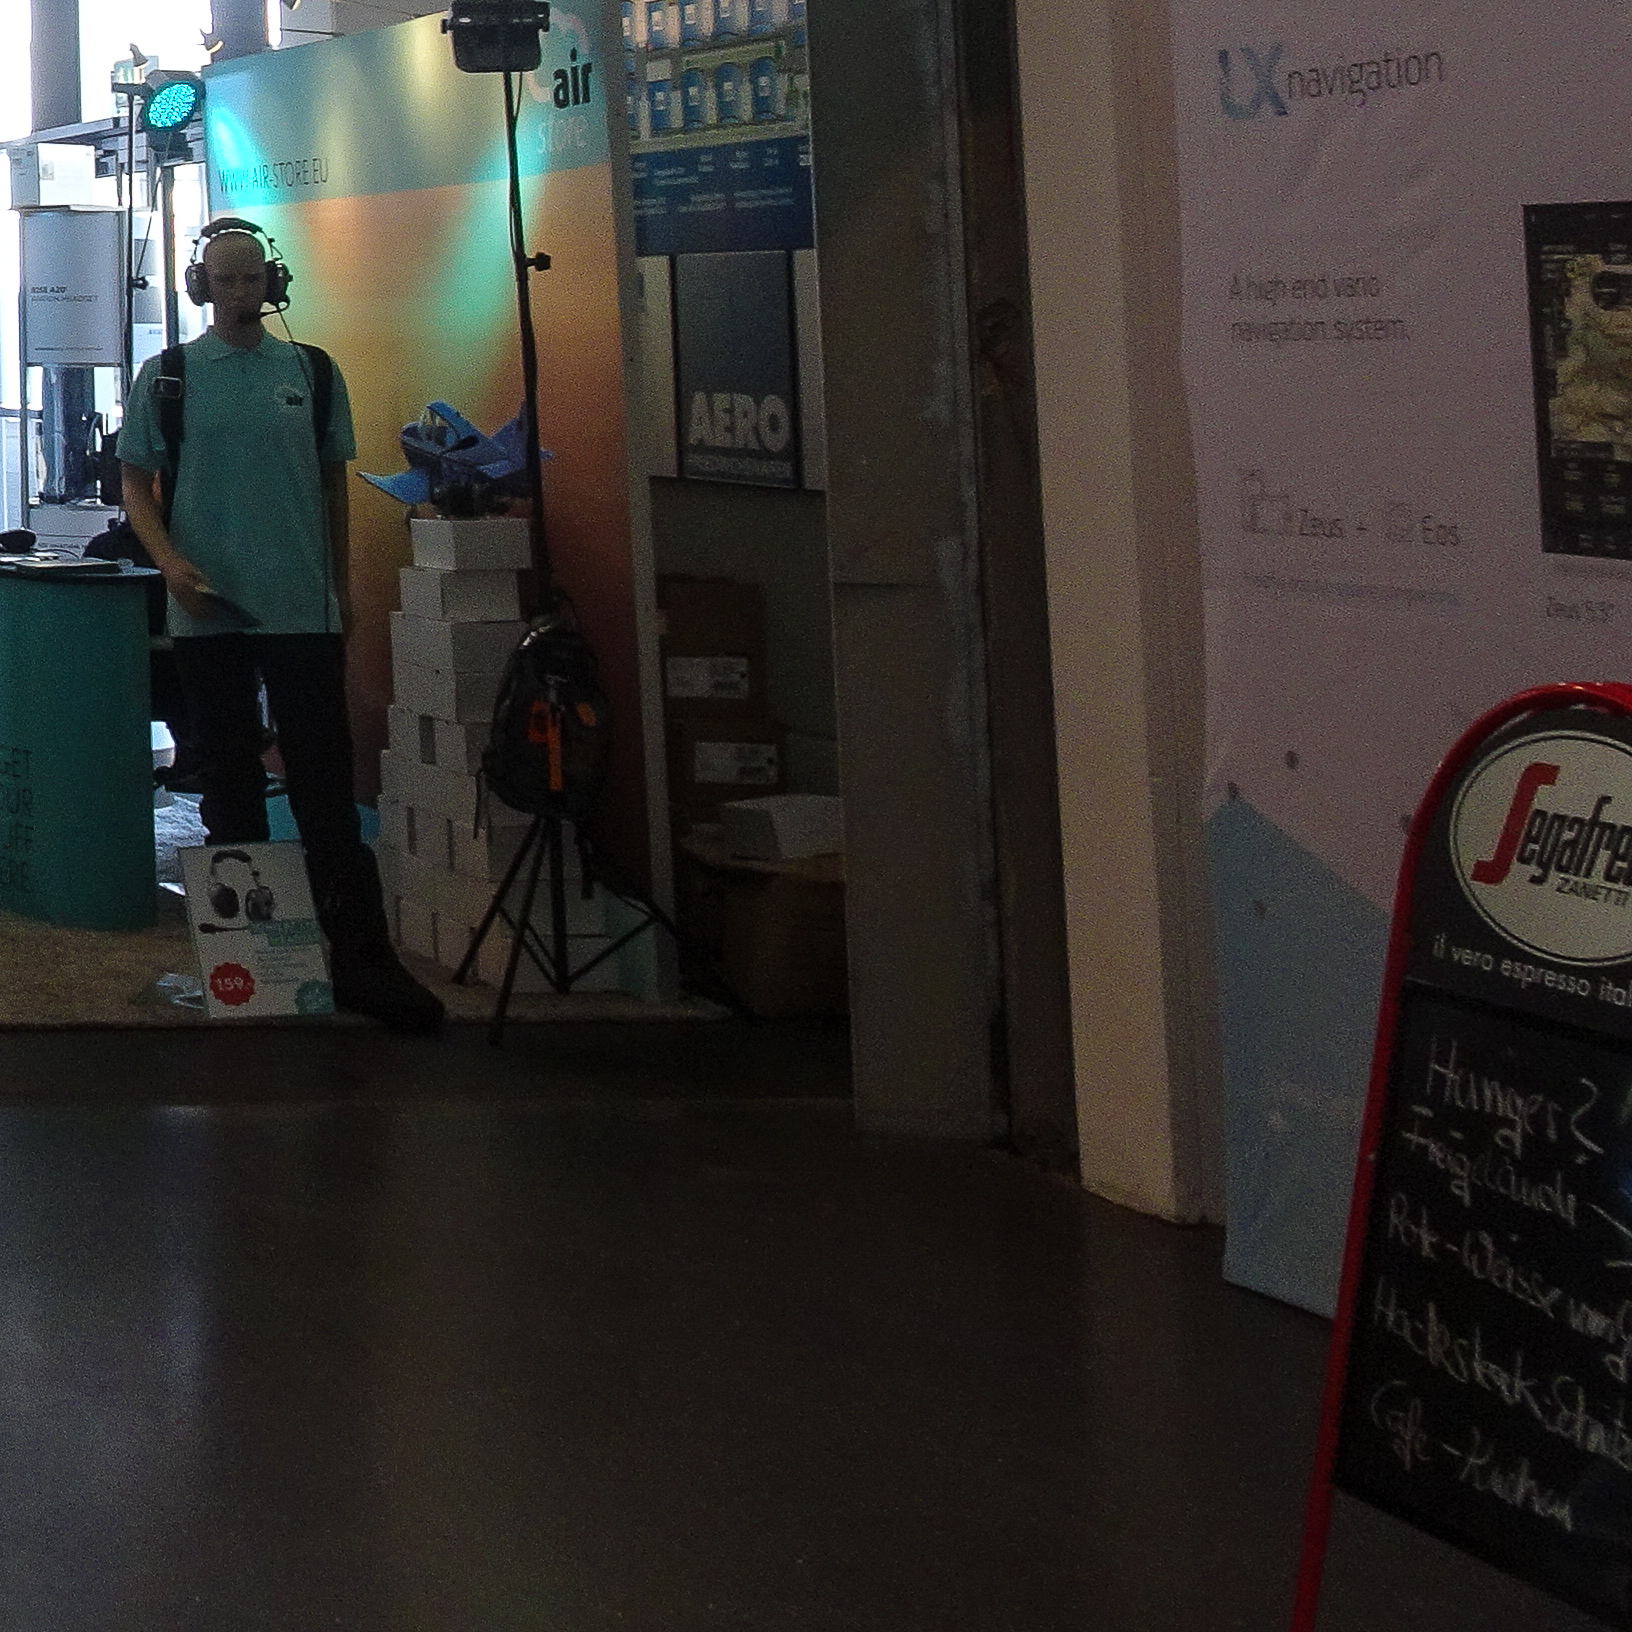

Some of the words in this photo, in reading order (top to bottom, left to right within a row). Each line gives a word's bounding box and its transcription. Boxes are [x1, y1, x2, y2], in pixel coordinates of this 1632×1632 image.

[553, 47, 593, 109] air
[1288, 51, 1445, 108] navigation
[688, 390, 790, 454] AERO
[1471, 762, 1632, 886] Segafre
[1452, 943, 1495, 971] vero
[1499, 956, 1592, 998] espresso
